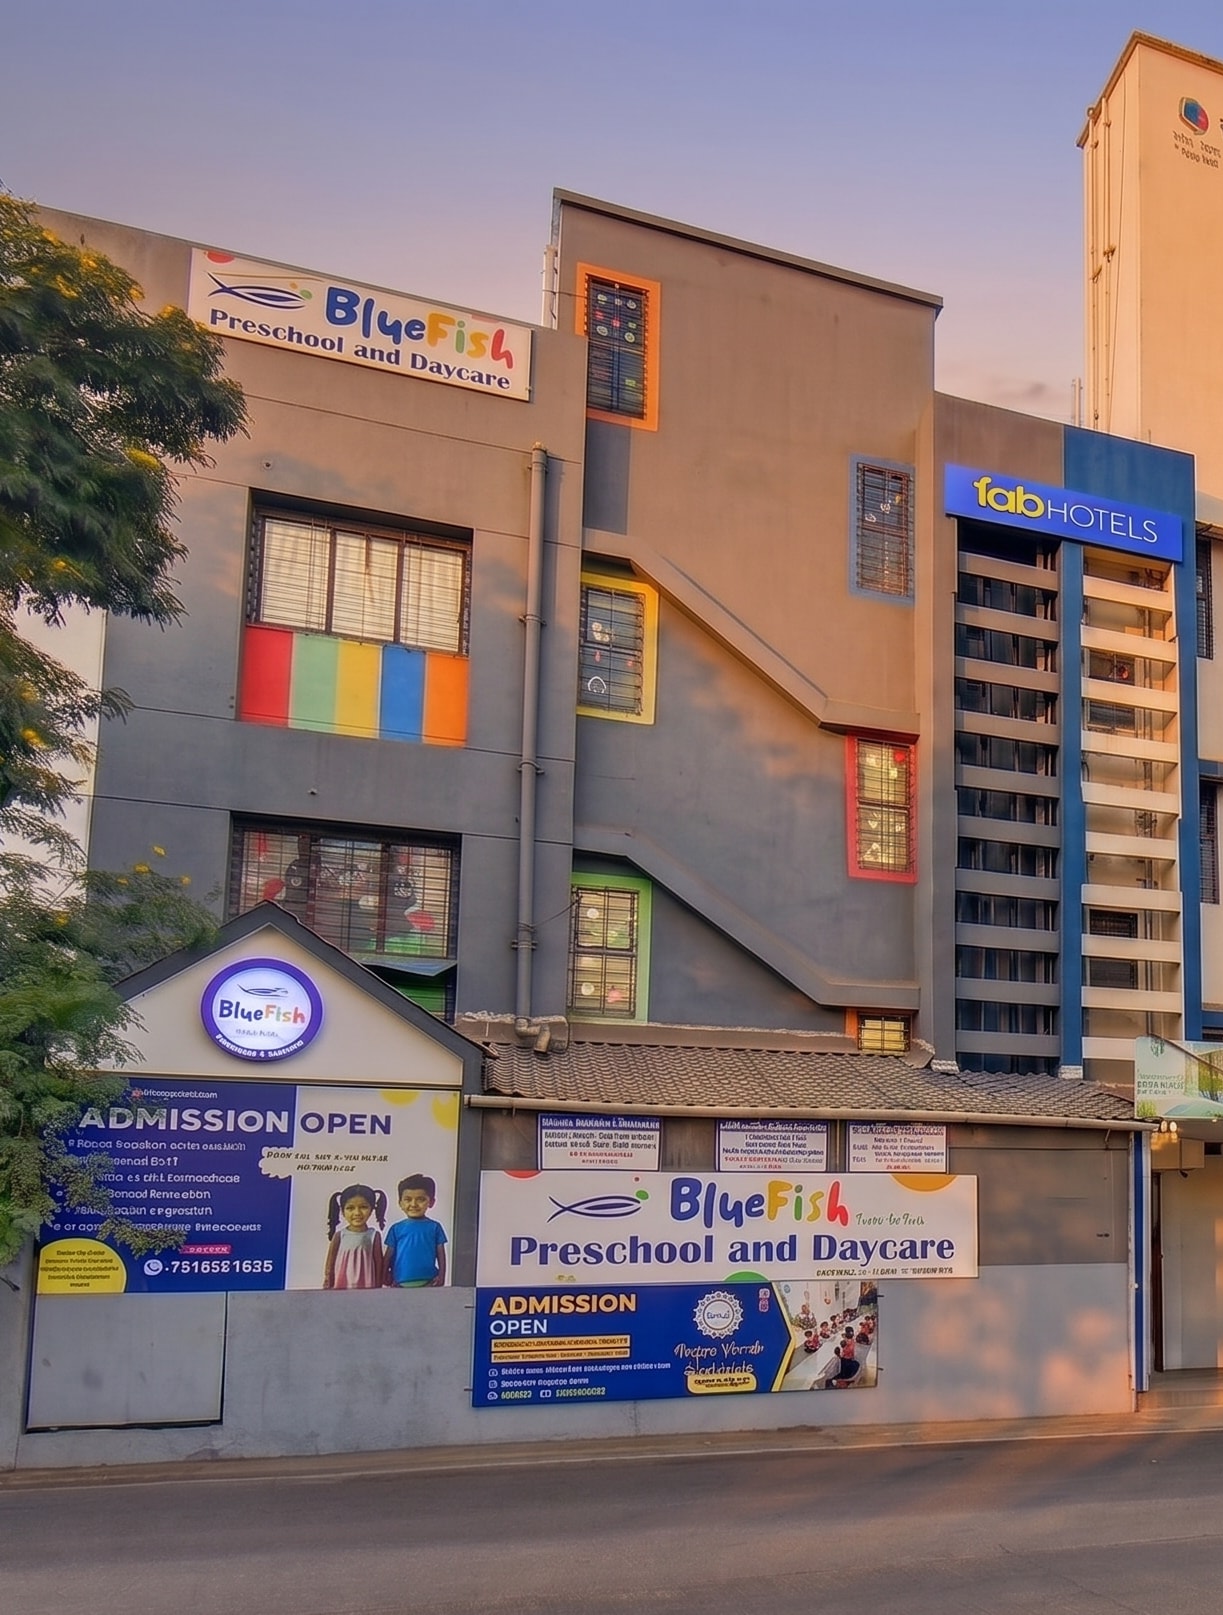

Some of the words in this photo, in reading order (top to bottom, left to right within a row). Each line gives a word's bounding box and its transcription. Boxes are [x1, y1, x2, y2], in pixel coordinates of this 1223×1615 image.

[325, 286, 514, 369] BlueFish
[209, 308, 344, 353] Preschool
[354, 343, 400, 366] and
[410, 353, 511, 390] Daycare
[79, 1107, 289, 1133] ADMISSION
[300, 1112, 392, 1135] OPEN
[670, 1177, 849, 1228] BlueFish
[510, 1235, 714, 1267] Preschool
[728, 1234, 797, 1263] and
[812, 1234, 955, 1267] Daycare
[489, 1294, 636, 1316] ADMISSION
[489, 1319, 548, 1335] OPEN
